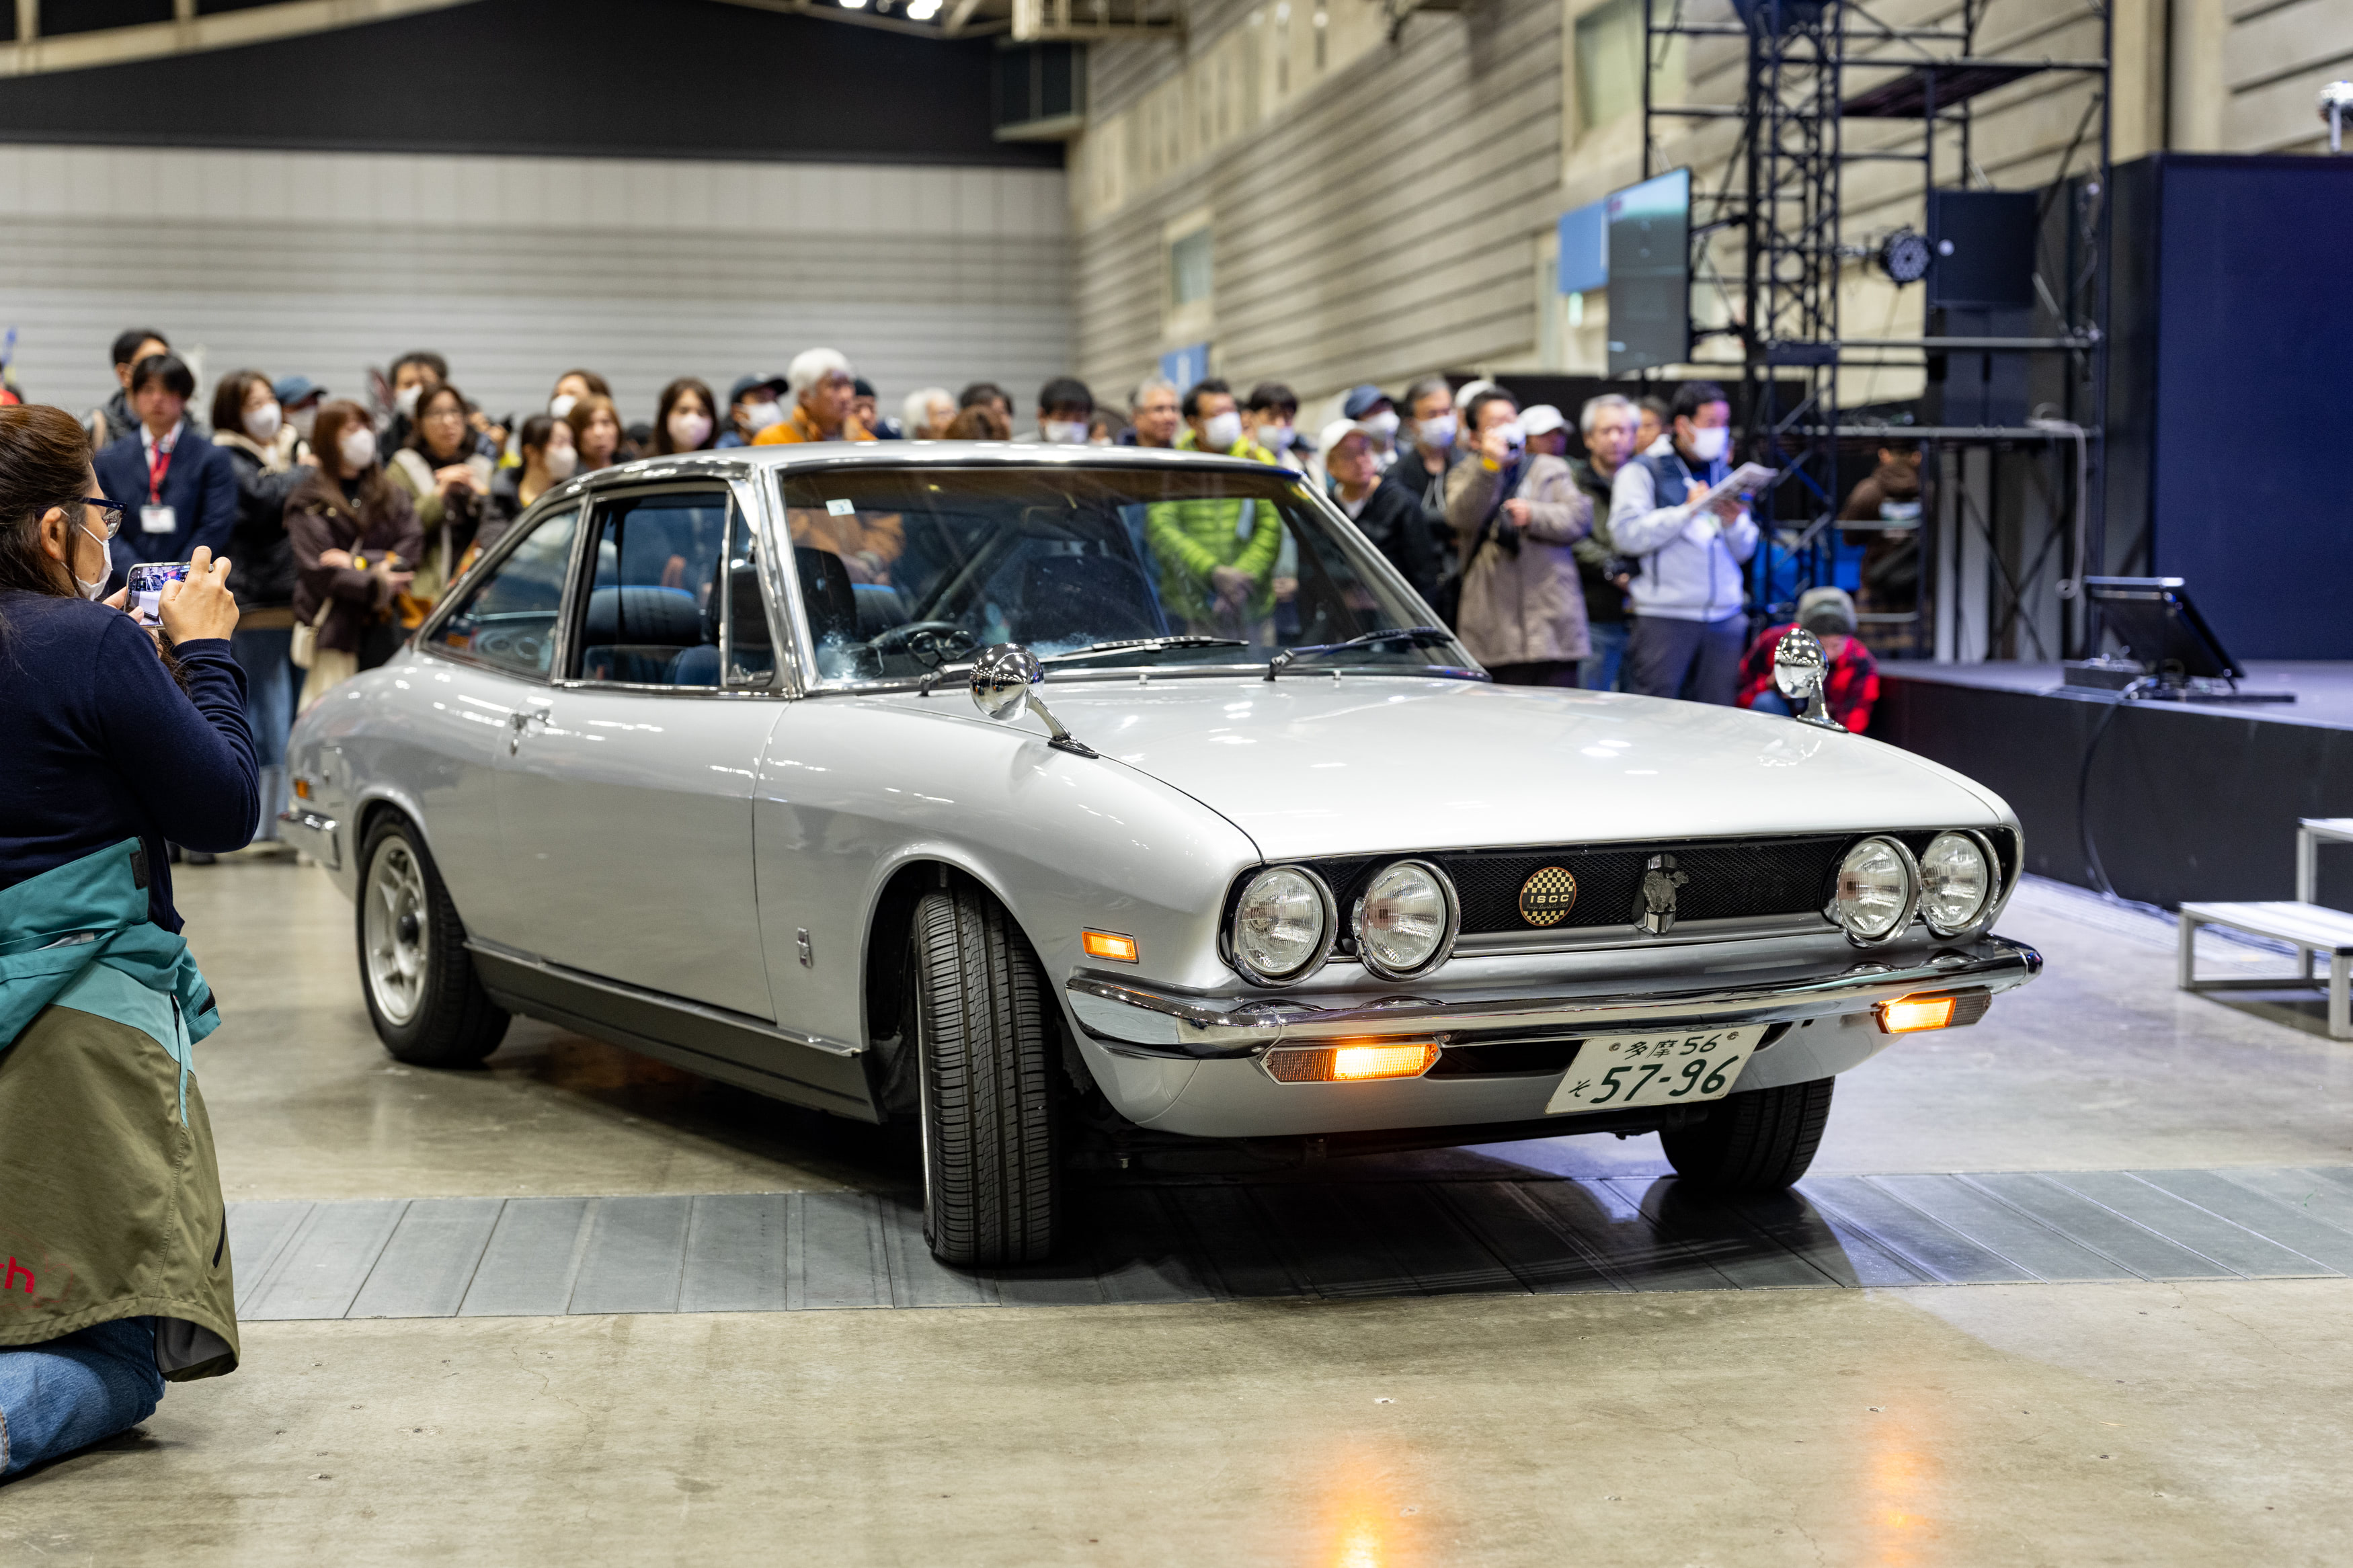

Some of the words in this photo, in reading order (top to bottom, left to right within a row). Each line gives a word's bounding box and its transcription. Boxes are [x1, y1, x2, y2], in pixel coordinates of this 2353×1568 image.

[1530, 895, 1569, 903] ISCC
[1624, 1040, 1679, 1060] 多摩
[1679, 1034, 1722, 1055] 56
[1568, 1079, 1591, 1097] そ
[1589, 1055, 1739, 1104] 57-96
[0, 1256, 35, 1293] h
